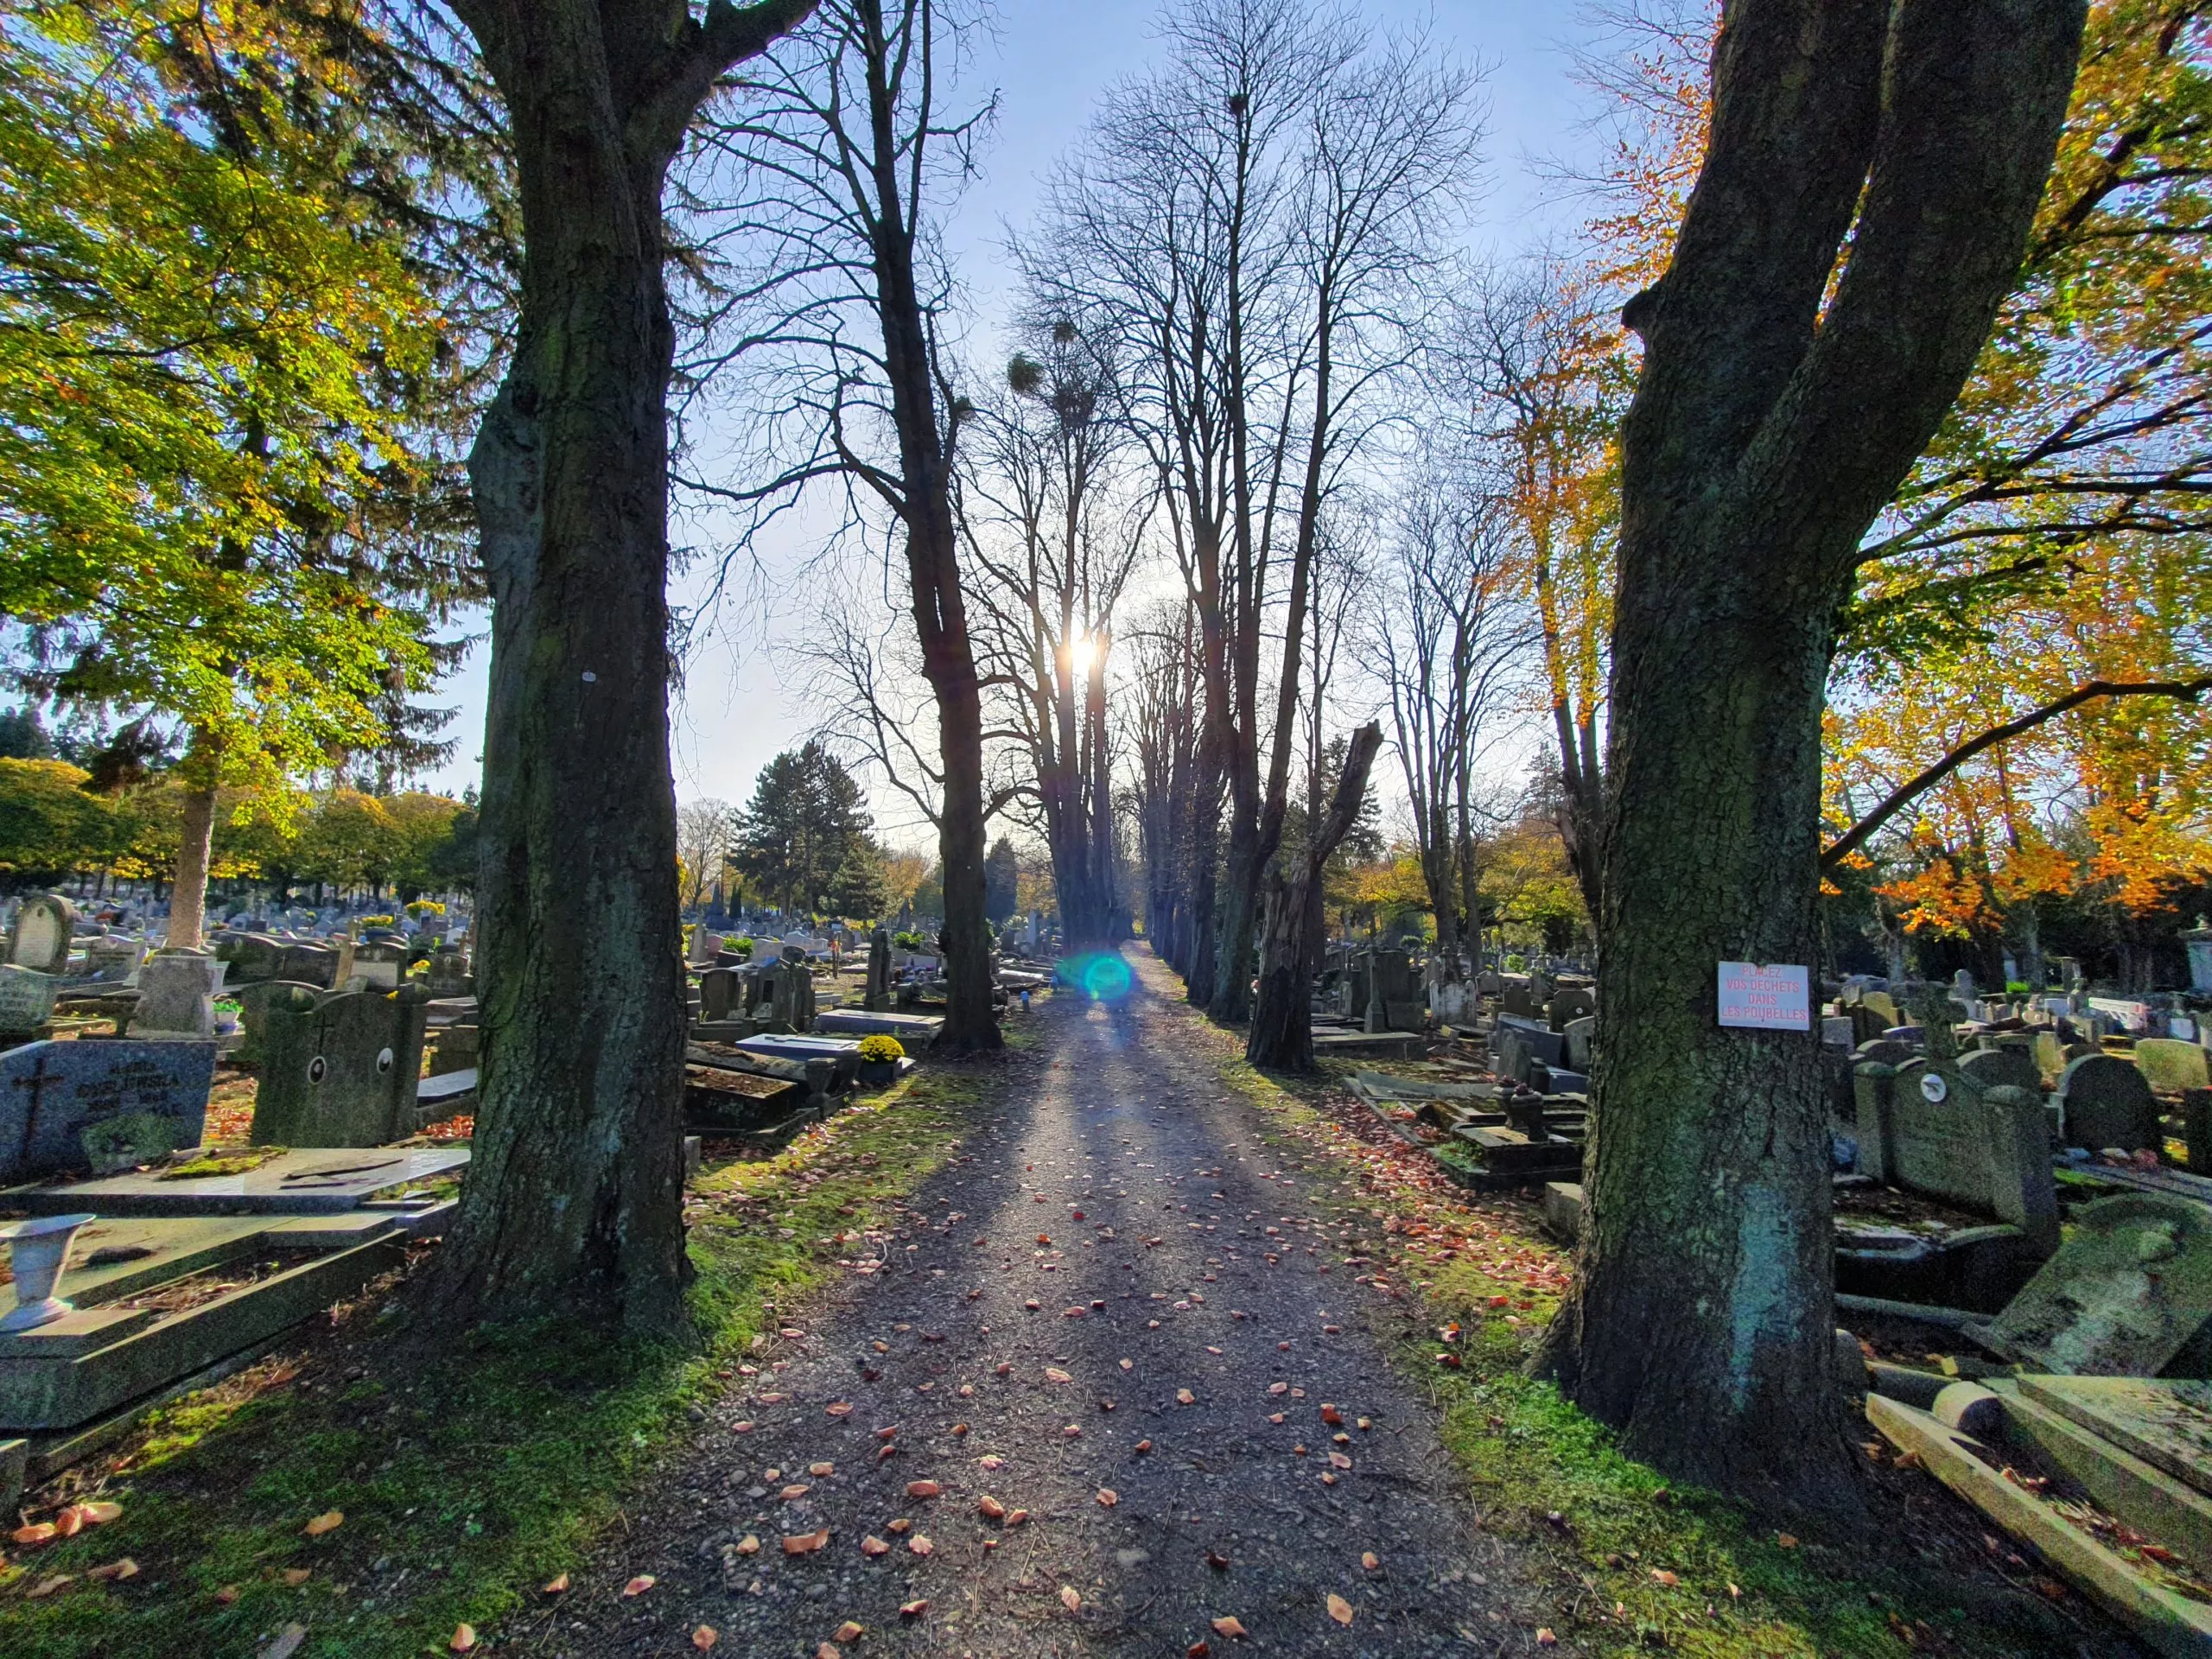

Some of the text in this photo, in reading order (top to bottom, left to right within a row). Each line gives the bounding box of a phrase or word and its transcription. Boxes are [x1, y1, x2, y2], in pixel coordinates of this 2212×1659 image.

[1741, 965, 1783, 978] PLACEZ
[1726, 978, 1799, 993] VOS DECHETS
[1748, 994, 1777, 1005] DANS
[1721, 1006, 1806, 1020] LES POUBELLES
